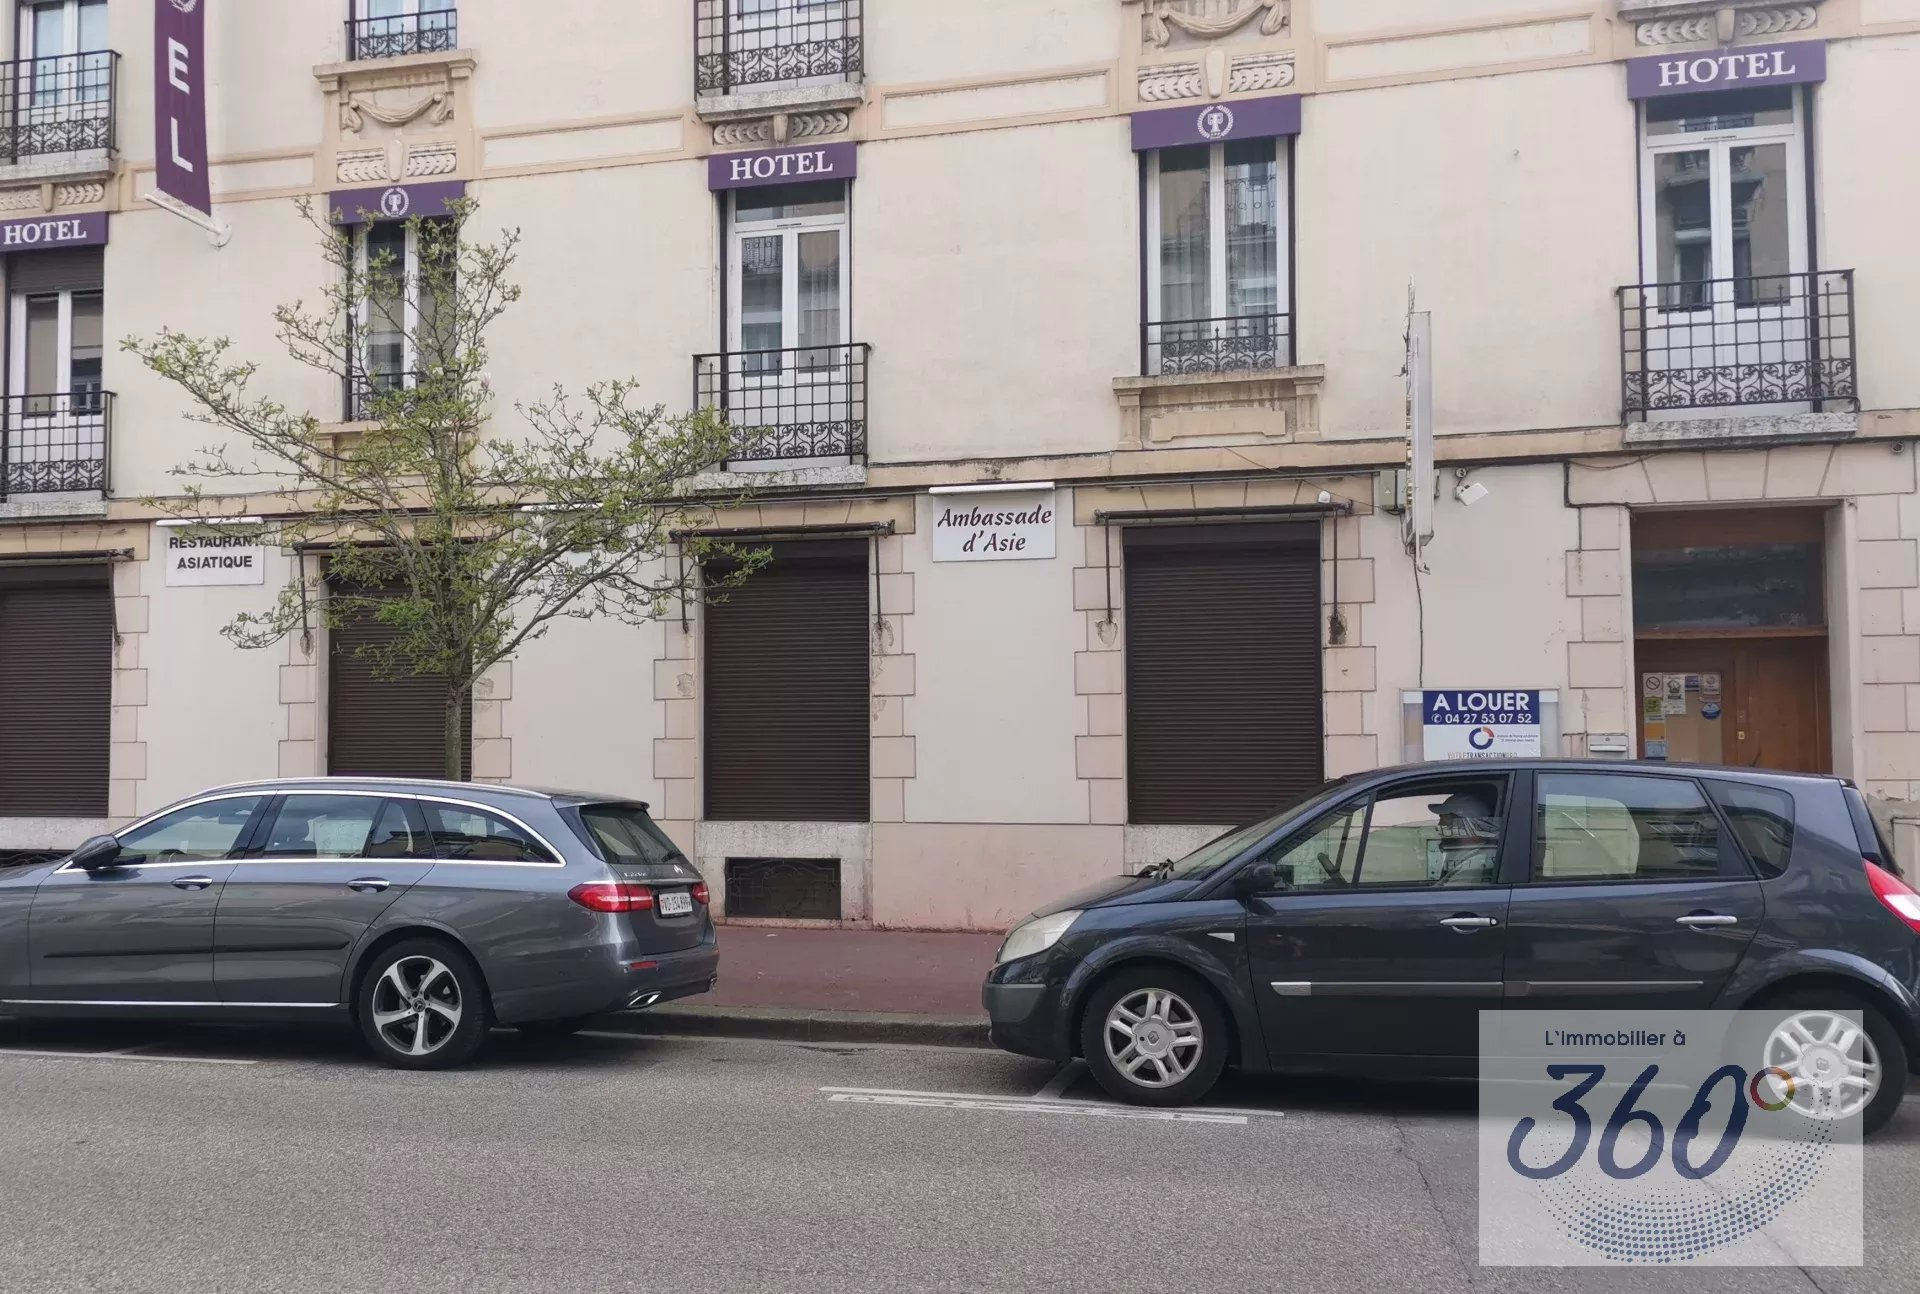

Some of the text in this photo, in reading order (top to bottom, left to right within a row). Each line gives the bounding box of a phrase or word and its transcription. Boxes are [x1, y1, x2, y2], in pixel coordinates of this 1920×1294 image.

[1658, 50, 1796, 87] HOTEL
[729, 150, 834, 180] HOTEL
[3, 219, 88, 245] HOTEL
[937, 503, 1052, 528] Ambassade
[962, 530, 1026, 552] d'Asie
[177, 555, 253, 569] ASIATIQUE
[1432, 692, 1530, 711] A LOUER
[1445, 713, 1532, 724] 04 27 53 07 52
